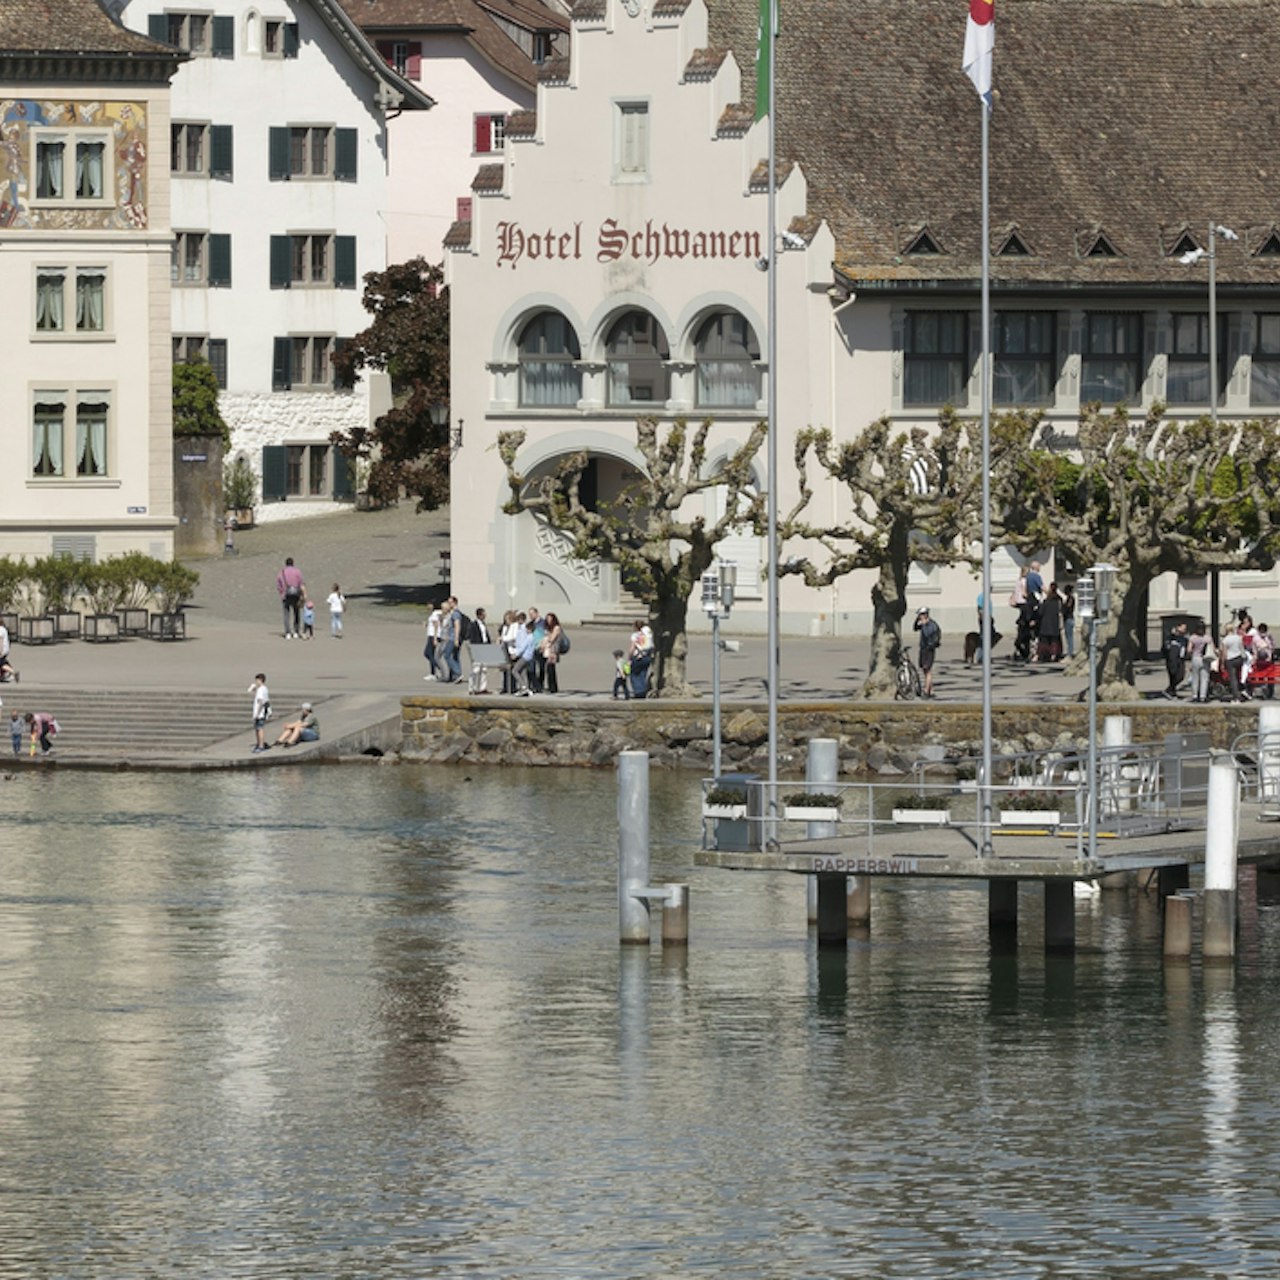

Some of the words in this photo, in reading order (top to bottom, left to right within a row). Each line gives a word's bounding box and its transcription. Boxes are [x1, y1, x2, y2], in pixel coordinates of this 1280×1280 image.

[496, 220, 583, 270] Hotel
[596, 218, 761, 267] Schwanen
[814, 859, 917, 873] RAPPERSWIL
